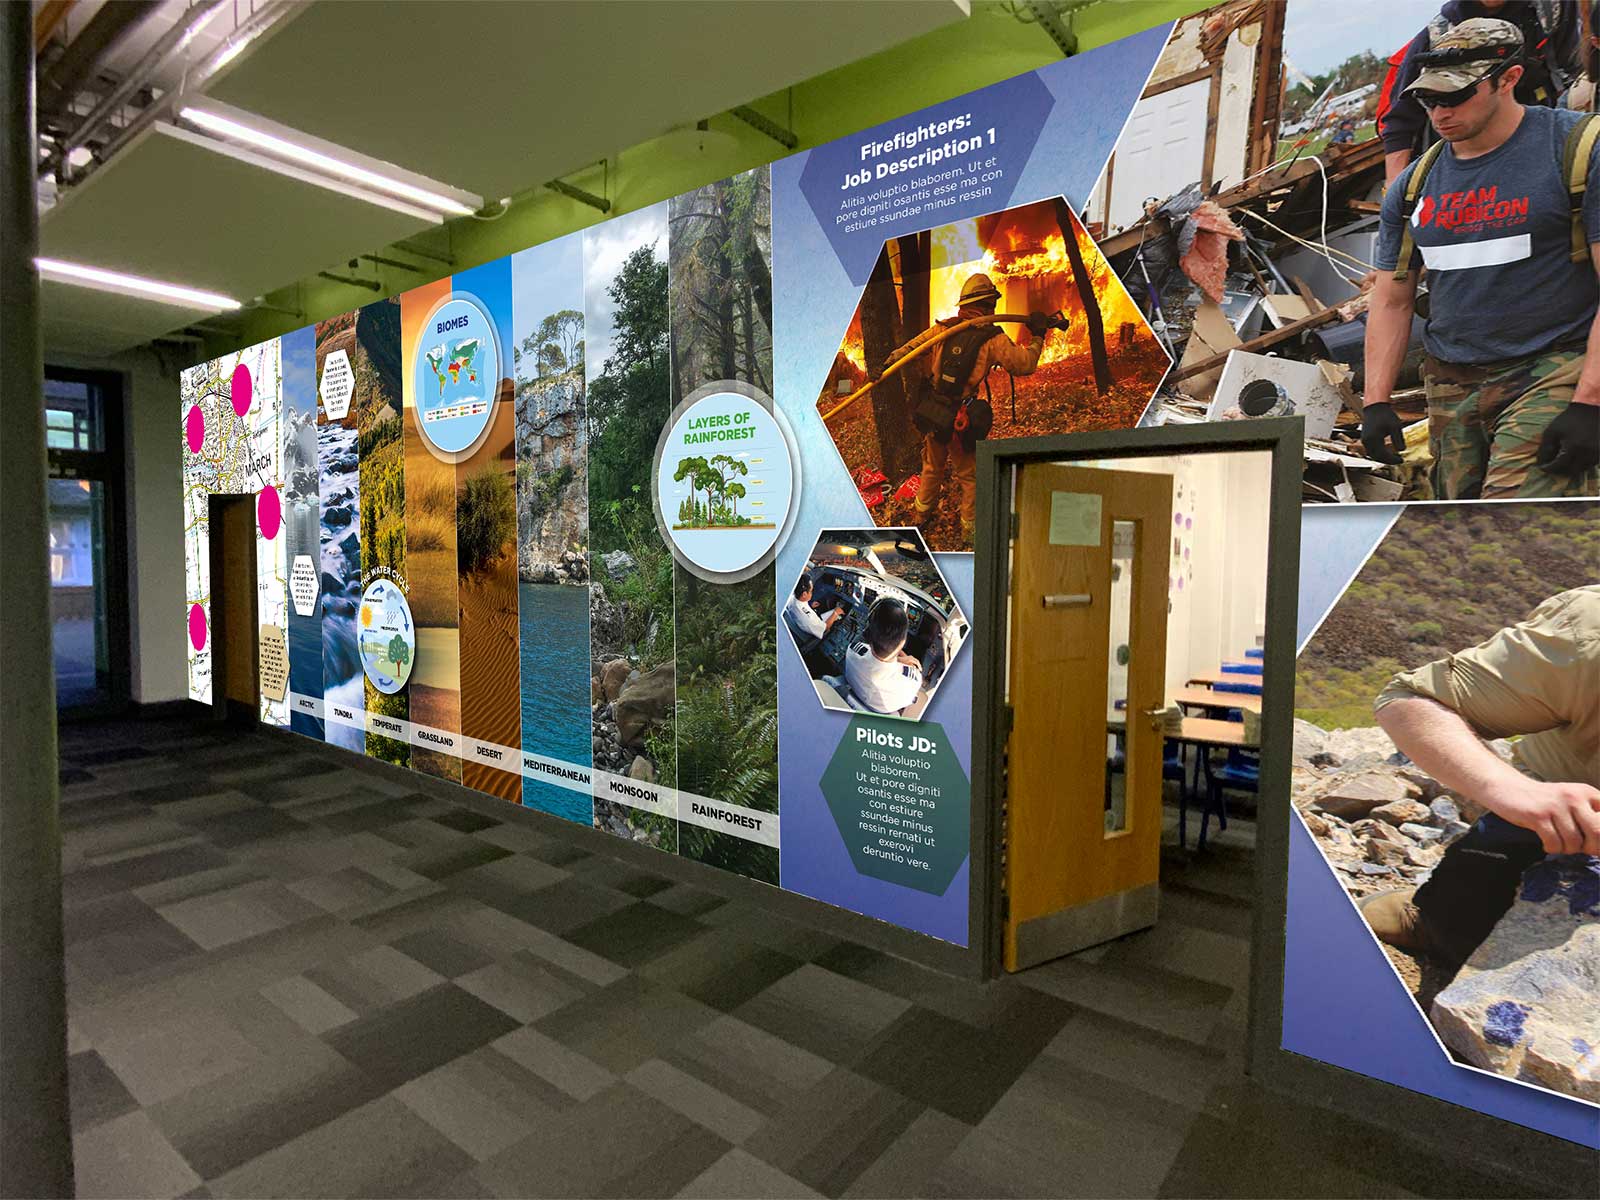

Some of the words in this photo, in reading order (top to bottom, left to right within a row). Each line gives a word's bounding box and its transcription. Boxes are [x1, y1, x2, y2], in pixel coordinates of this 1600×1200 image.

[861, 113, 972, 160] Firefighters:
[841, 168, 872, 190] Job
[876, 136, 982, 180] Description
[986, 127, 996, 145] 1
[840, 194, 865, 210] Alitia
[867, 182, 908, 203] voluptio
[911, 167, 965, 190] blaborem.
[968, 161, 982, 173] Ut
[985, 157, 997, 168] et
[836, 210, 858, 225] pore
[860, 200, 891, 221] digniti
[894, 191, 931, 207] osantis
[933, 183, 957, 196] esse
[960, 177, 978, 188] ma
[981, 169, 1003, 183] con
[844, 216, 877, 233] estiure
[879, 204, 921, 224] ssundae
[924, 197, 956, 213] minus
[959, 185, 992, 202] ressin
[1440, 185, 1498, 210] TEAM
[1434, 195, 1529, 230] RUBICON
[437, 315, 469, 334] BIOMES
[688, 414, 730, 430] LAYERS
[734, 412, 750, 424] OF
[684, 427, 756, 445] RAINFOREST
[245, 452, 271, 477] MARCH
[371, 565, 391, 577] WATER
[391, 570, 410, 594] CYCLE
[299, 699, 315, 710] ARCTIC
[334, 708, 353, 720] TUNDRA
[372, 718, 402, 734] TEMPERATE
[418, 730, 454, 748] GRASSLAND
[856, 727, 903, 749] Pilots
[908, 736, 937, 755] JD:
[477, 746, 503, 761] DESERT
[861, 748, 886, 761] Alitia
[889, 752, 931, 770] voluptio
[523, 758, 591, 785] MEDITERRANEAN
[856, 771, 867, 783] Ut
[870, 774, 880, 785] et
[882, 777, 905, 792] pore
[908, 783, 941, 797] digniti
[871, 762, 920, 781] blaborem.
[610, 781, 658, 803] MONSOON
[857, 785, 892, 800] osantis
[894, 793, 916, 805] esse
[919, 798, 936, 809] ma
[692, 803, 762, 831] RAINFOREST
[860, 809, 900, 826] ssundae
[902, 818, 933, 834] minus
[869, 799, 887, 811] con
[889, 804, 924, 819] estiure
[859, 821, 886, 835] ressin
[888, 828, 922, 844] rernati
[924, 836, 936, 847] ut
[878, 837, 914, 854] exerovi
[862, 844, 904, 863] deruntio
[906, 857, 932, 871] vere.
